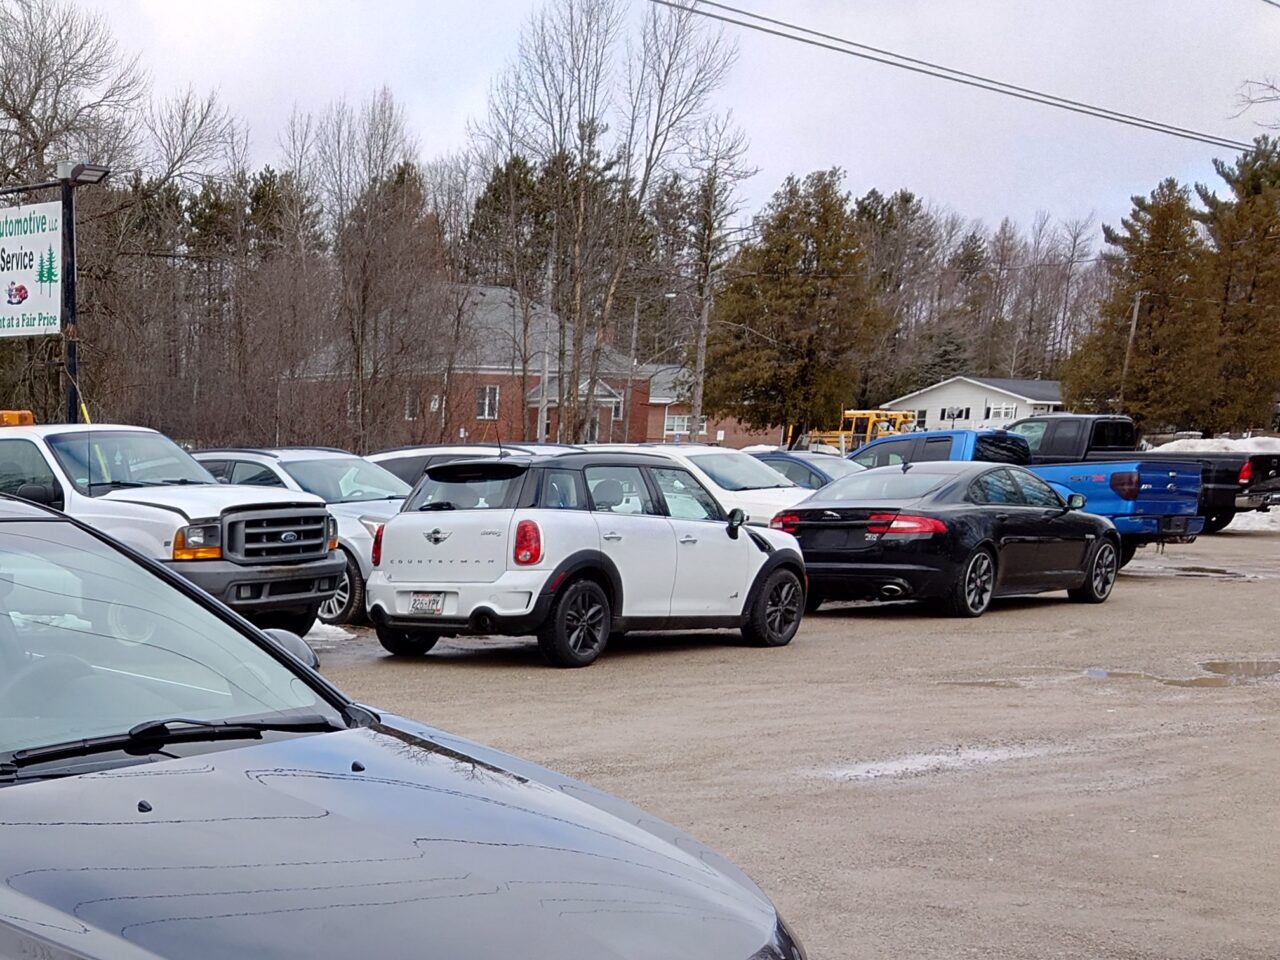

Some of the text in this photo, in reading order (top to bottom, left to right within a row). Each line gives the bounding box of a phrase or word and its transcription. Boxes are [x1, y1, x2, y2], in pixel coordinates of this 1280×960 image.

[48, 218, 58, 231] LLC
[0, 246, 34, 272] Service
[7, 316, 14, 327] at
[15, 318, 20, 327] a
[21, 313, 35, 326] Fair
[38, 312, 57, 326] Price
